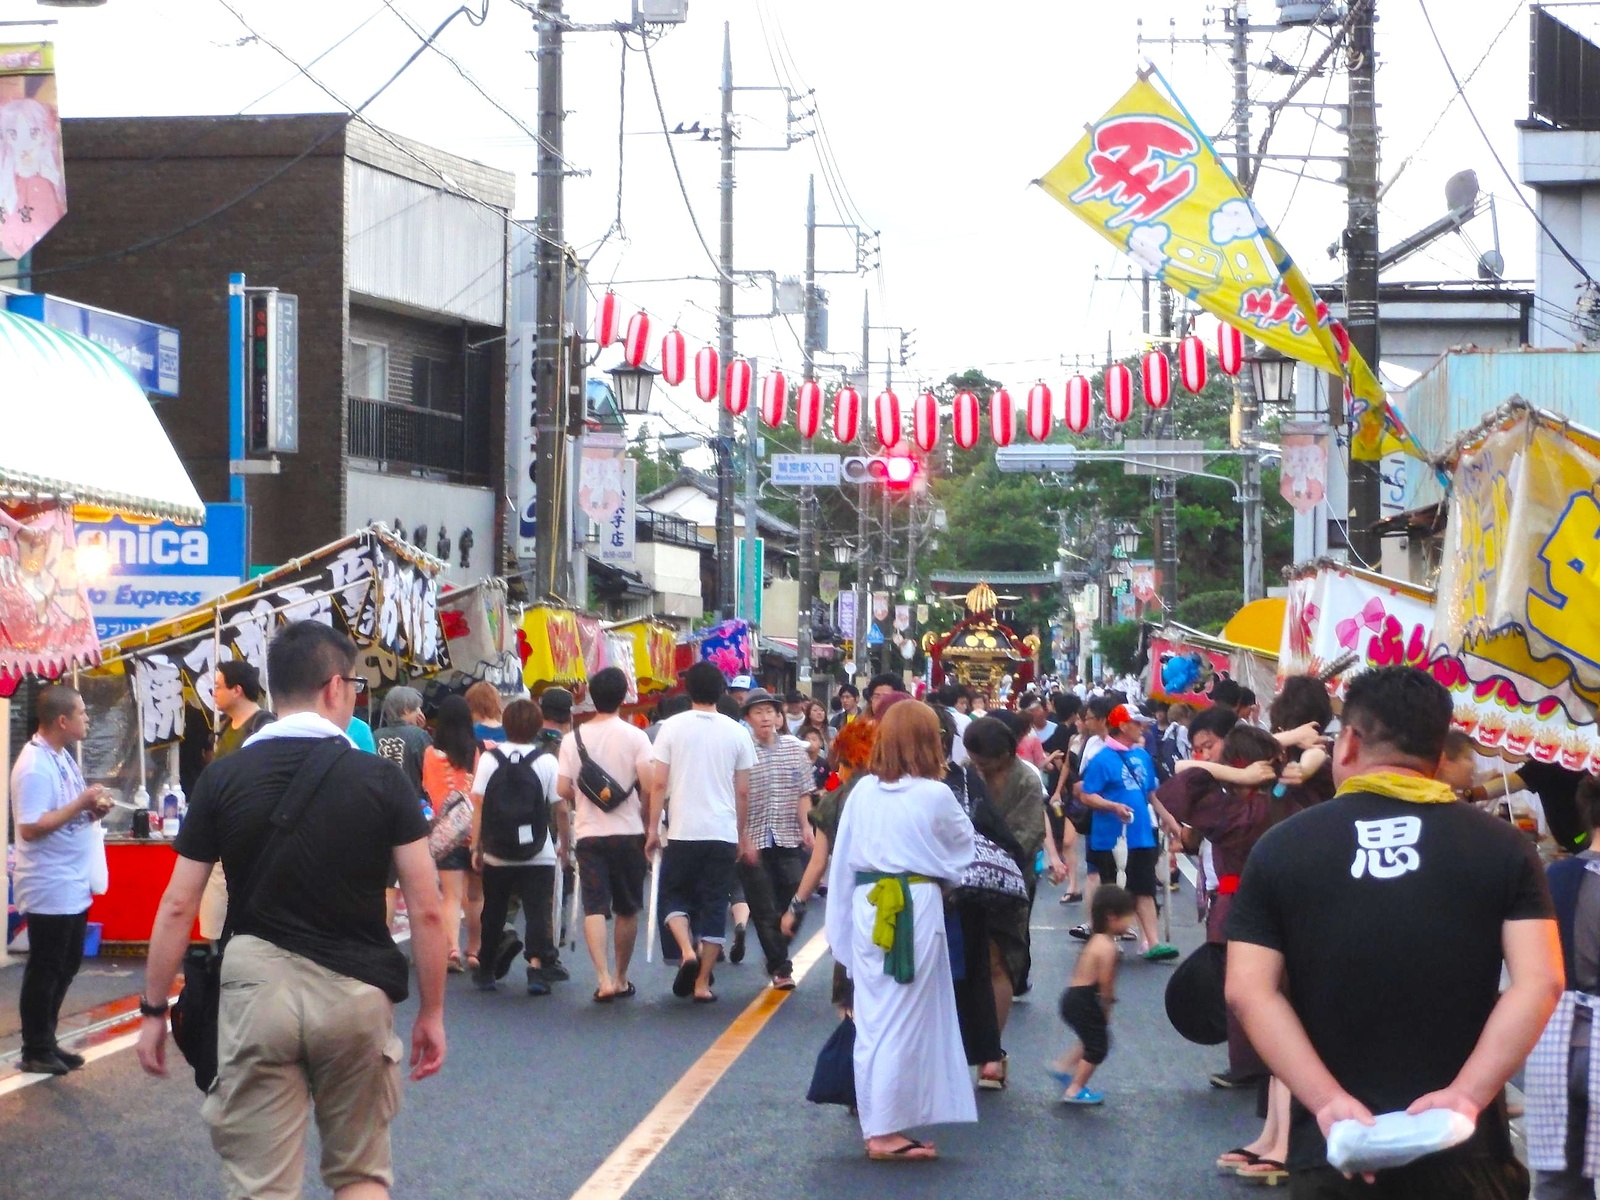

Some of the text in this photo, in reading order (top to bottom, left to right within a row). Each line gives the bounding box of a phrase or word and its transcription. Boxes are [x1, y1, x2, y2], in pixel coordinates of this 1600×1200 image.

[283, 303, 294, 445] コマーシャルフォト
[75, 525, 209, 565] onica
[114, 583, 202, 608] Express
[1350, 815, 1422, 879] 思
